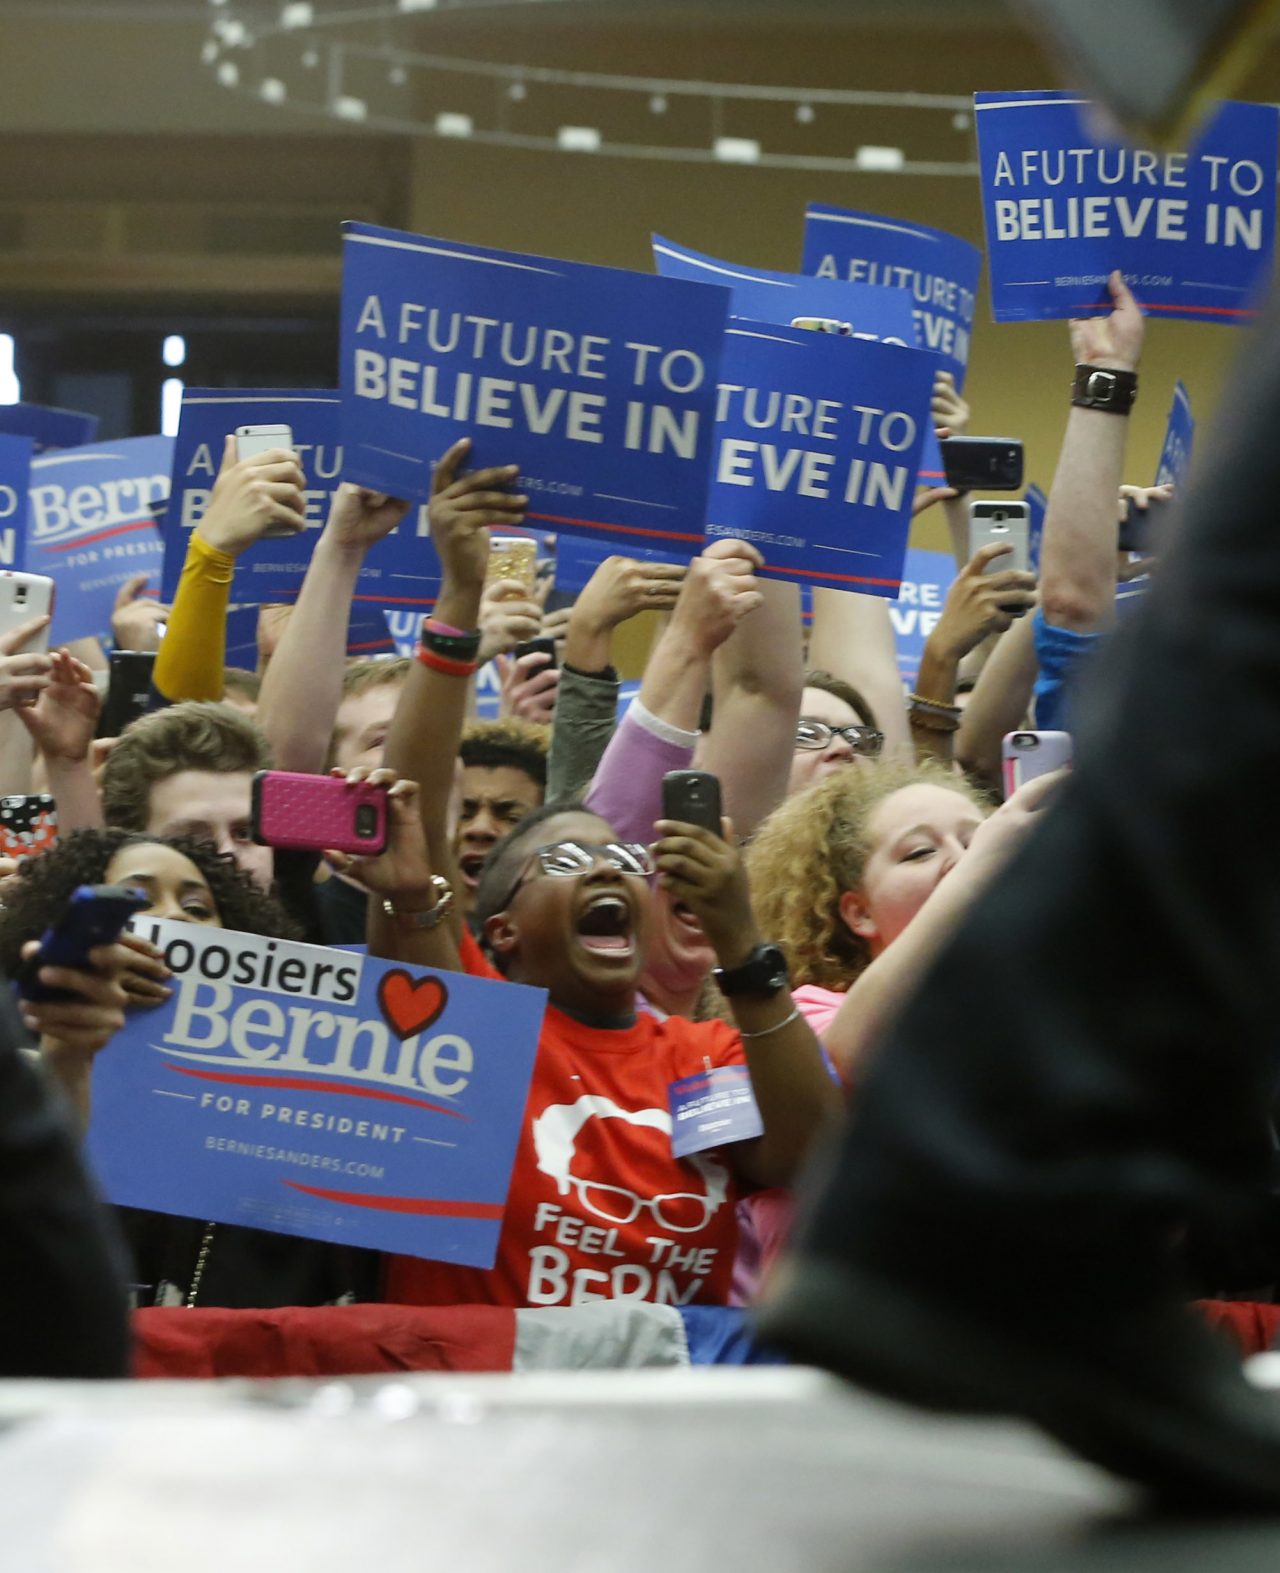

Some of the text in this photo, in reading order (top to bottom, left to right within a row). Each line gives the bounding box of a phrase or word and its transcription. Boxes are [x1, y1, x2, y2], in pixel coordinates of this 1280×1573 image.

[994, 149, 1264, 197] A FUTURE TO
[995, 196, 1263, 250] BELIEVE IN
[815, 254, 838, 280] A
[355, 295, 705, 394] A FUTURE TO
[354, 348, 700, 460] BELIEVE IN
[715, 383, 917, 452] TURE TO
[186, 443, 215, 477] A
[844, 458, 909, 512] IN
[28, 474, 173, 538] Bern
[163, 980, 474, 1097] Bernie
[200, 1092, 406, 1143] FOR PRESIDENT
[205, 1135, 385, 1179] BERNIESANDERS.COM
[533, 1202, 719, 1275] FEEL THE
